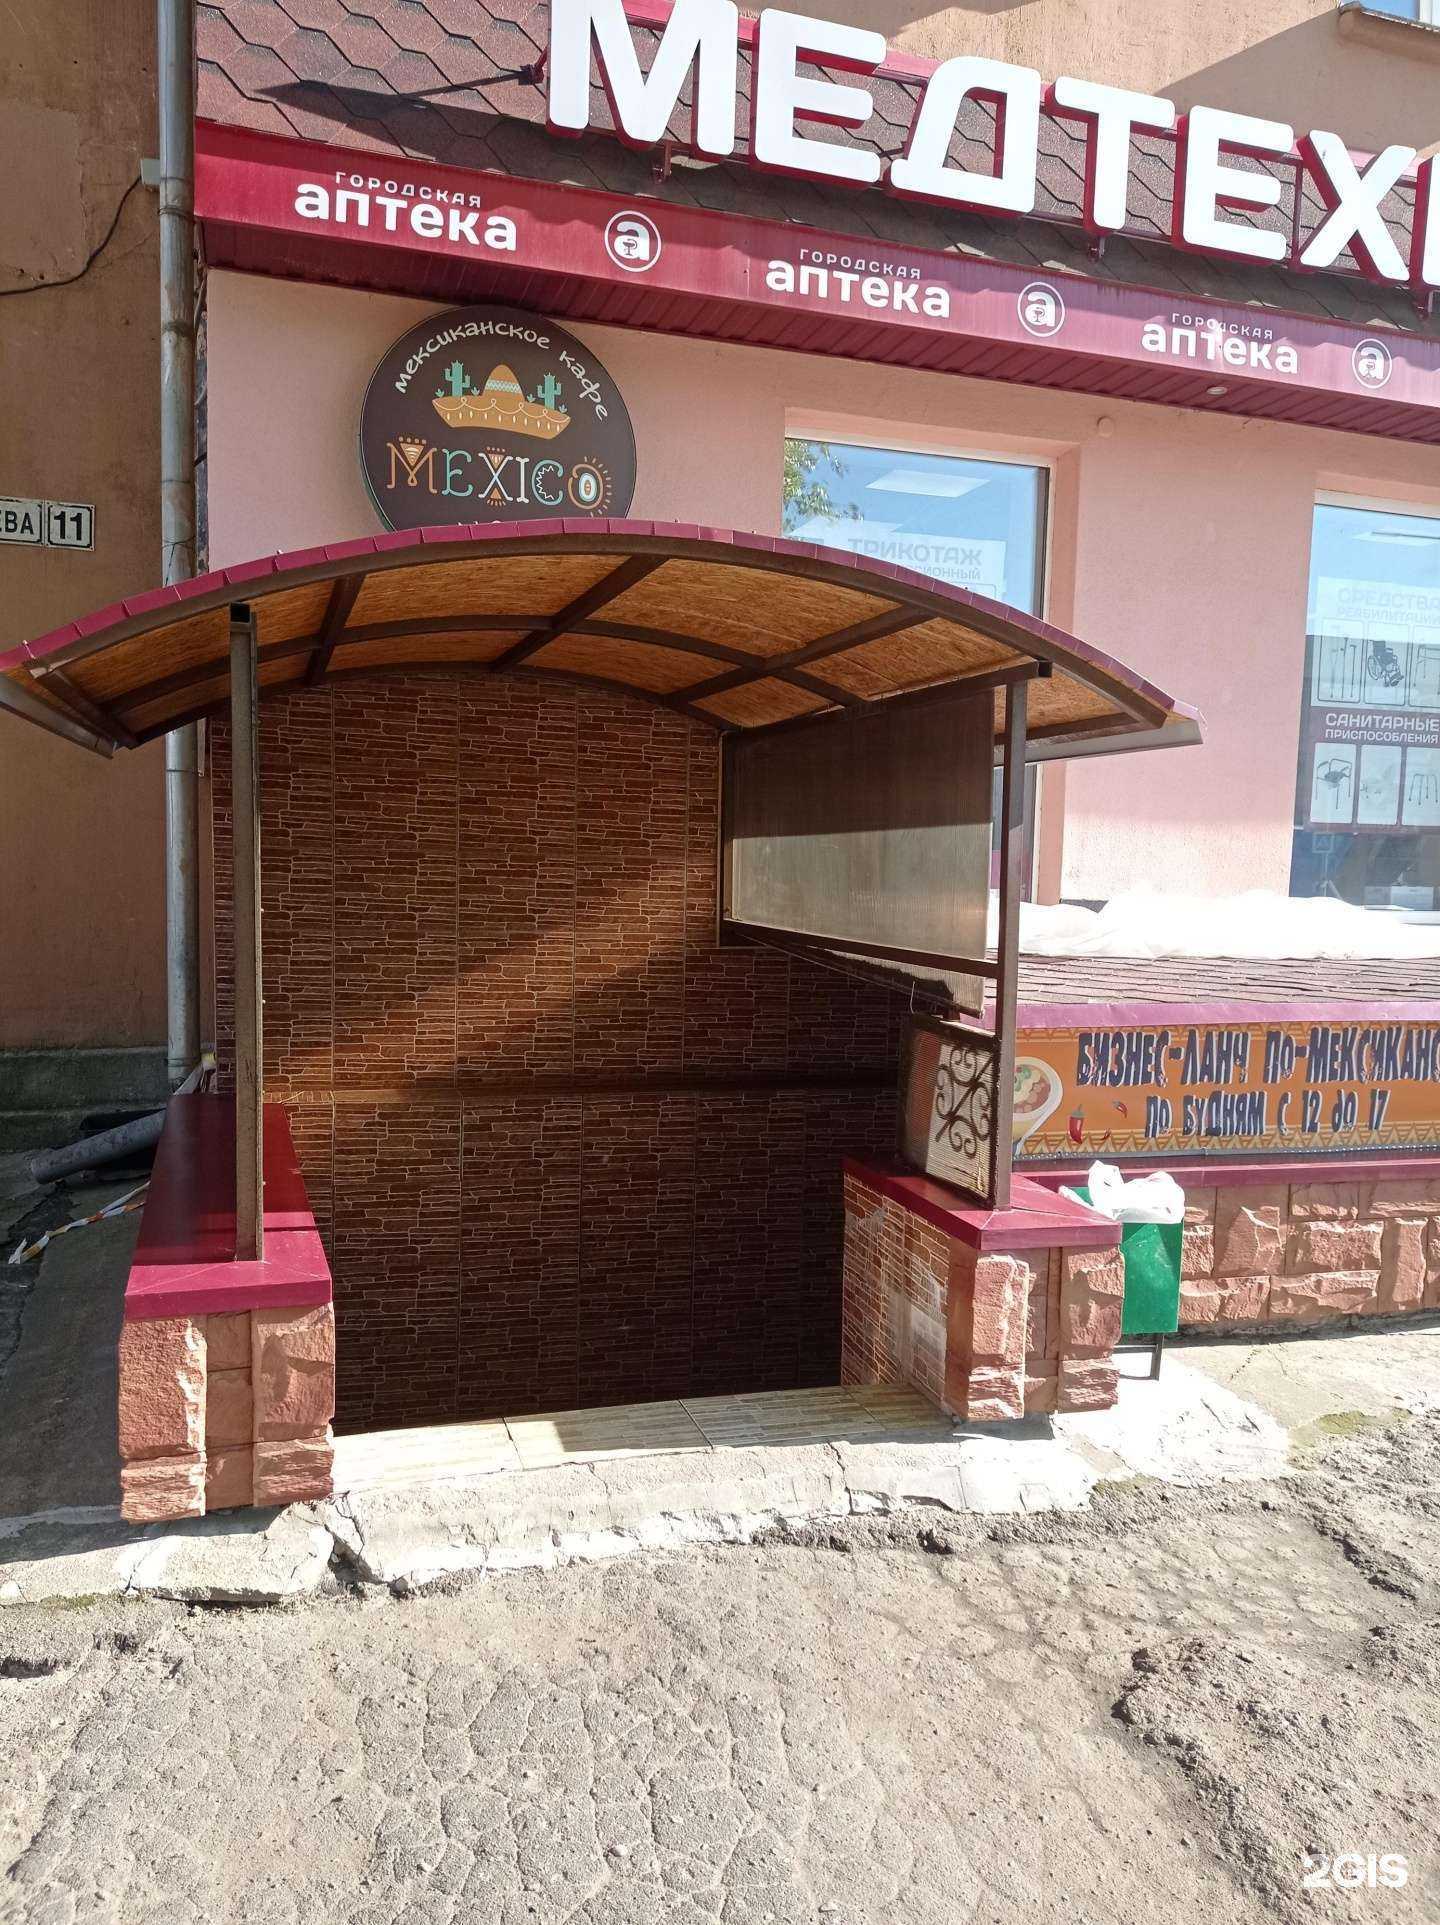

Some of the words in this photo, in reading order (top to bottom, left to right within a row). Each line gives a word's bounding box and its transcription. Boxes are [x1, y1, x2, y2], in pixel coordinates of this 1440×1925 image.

[547, 0, 1440, 286] МЕДТЕХ
[334, 171, 483, 208] ГОРОДСКАЯ
[294, 182, 518, 252] аптека
[799, 248, 922, 281] ГОРОДСКАЯ
[765, 259, 951, 319] аптека
[1141, 323, 1299, 374] аптека
[1171, 312, 1273, 340] ГОРОДСКАЯ
[394, 320, 550, 394] мексиканское
[559, 350, 609, 422] кафе
[386, 441, 605, 511] MEXICO
[0, 510, 34, 535] ВА
[53, 511, 83, 541] 11
[847, 537, 983, 567] ТРИКОТАЖ
[1325, 713, 1440, 732] САНИТАРНЫЕ
[1325, 729, 1439, 744] ПРИСПОСОБЛЕНИЯ
[1076, 1029, 1252, 1088] БИЗНЕС-ЛАНЧ
[1302, 1089, 1323, 1134] 12
[1368, 1088, 1391, 1132] 17
